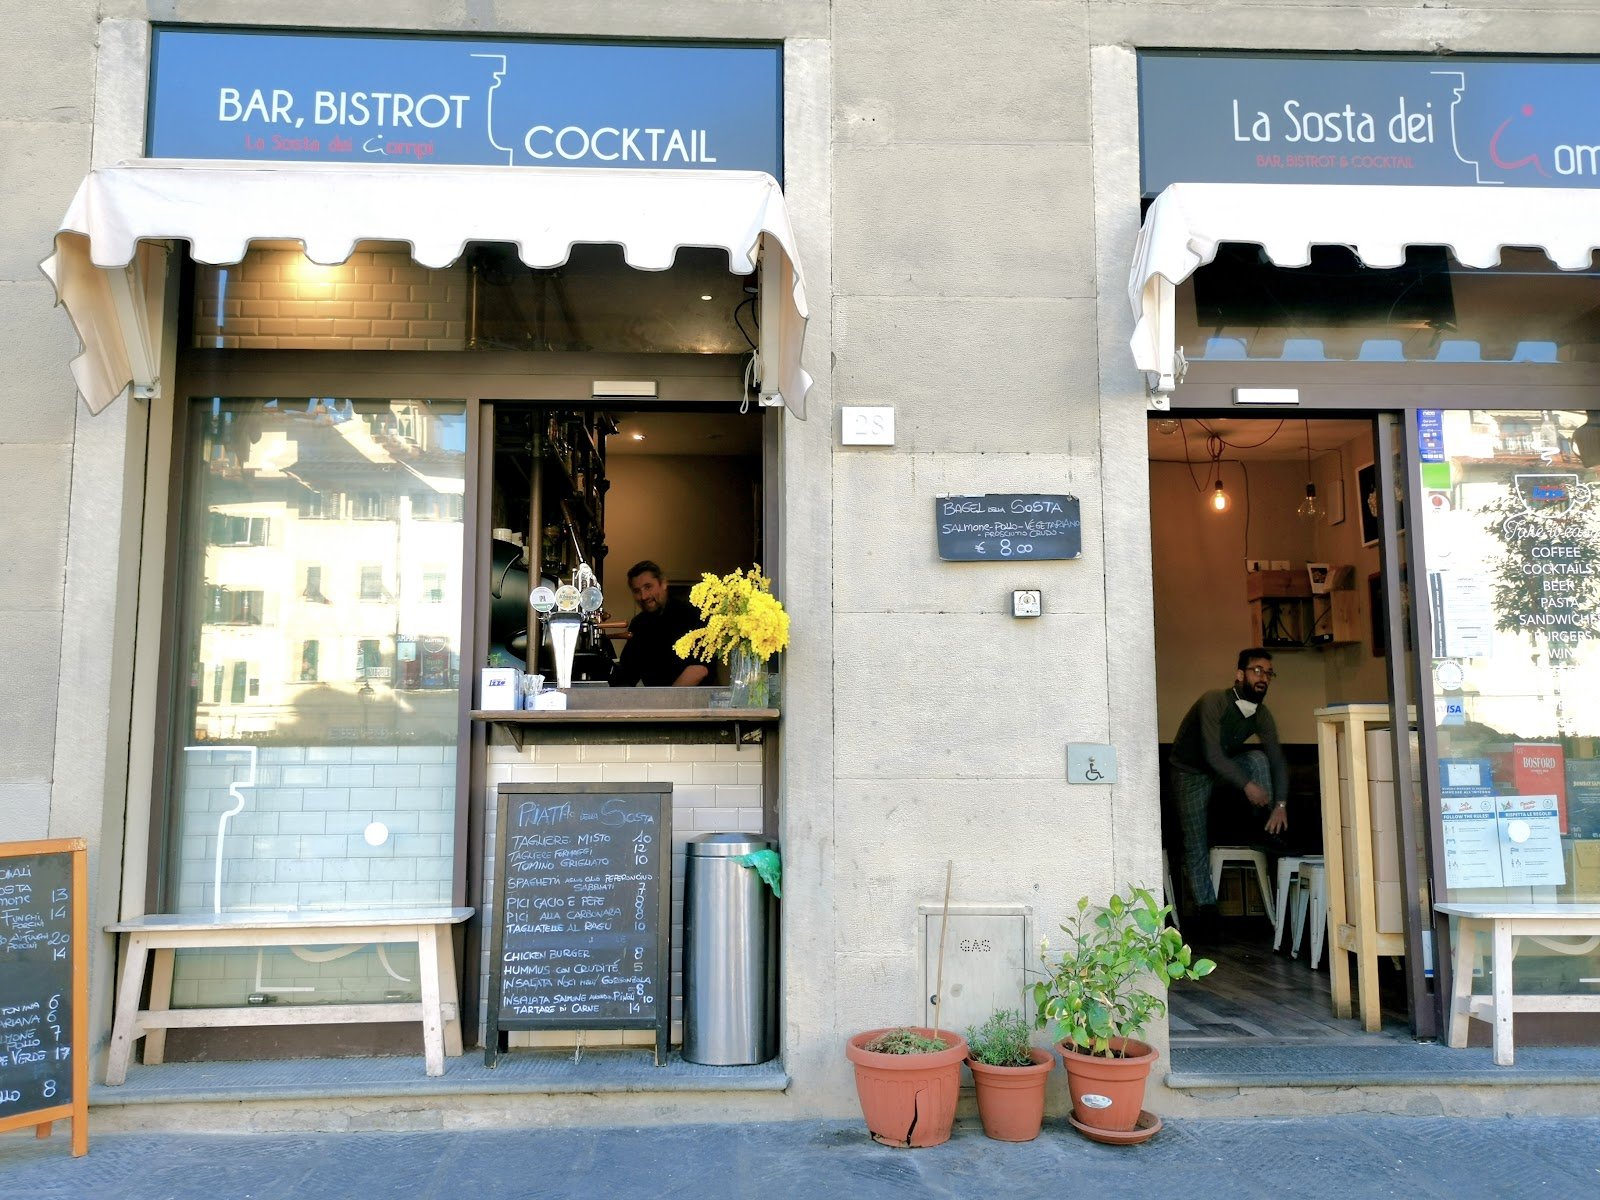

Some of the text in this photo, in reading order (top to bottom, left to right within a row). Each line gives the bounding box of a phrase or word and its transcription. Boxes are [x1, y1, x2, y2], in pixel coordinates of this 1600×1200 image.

[218, 88, 470, 129] BAR, BISTROT
[1233, 99, 1271, 142] La
[1284, 100, 1375, 143] Sosta
[1388, 97, 1434, 144] dei
[245, 135, 264, 150] La
[271, 135, 320, 152] Sosta
[329, 135, 353, 152] dei
[525, 125, 716, 163] COCKTAIL
[1286, 155, 1335, 168] BISTROT
[1352, 156, 1414, 168] COCKTAIL
[943, 502, 986, 515] BAGEL
[1532, 547, 1581, 557] COFFEE
[1523, 564, 1592, 574] COCKTAILS
[1543, 581, 1574, 591] BEER
[1541, 598, 1579, 607] PASTA
[1523, 756, 1556, 769] BOSFORD
[632, 830, 652, 844] 10
[634, 844, 647, 854] 12
[512, 855, 648, 872] TOMINO GRIGLIATO 10
[638, 882, 646, 895] 7
[52, 888, 69, 903] 13
[635, 895, 645, 908] 8
[506, 897, 530, 910] PICI
[50, 905, 66, 920] 14
[567, 907, 622, 920] CARBONARA
[635, 908, 644, 920] 8
[506, 923, 565, 934] TAGLIATELLE
[634, 922, 646, 932] 10
[47, 931, 70, 946] 20
[960, 939, 991, 952] GAS
[53, 947, 66, 961] 14
[504, 947, 644, 962] CHICKEN BURGER 8
[504, 965, 550, 975] HUMMUS
[634, 962, 643, 972] 5
[636, 983, 644, 995] 8
[48, 994, 60, 1010] 6
[503, 995, 551, 1008] INSALATA
[643, 995, 654, 1004] 10
[513, 1005, 556, 1014] TARTARE
[571, 1003, 599, 1013] CARNE
[629, 1002, 640, 1014] 14
[47, 1010, 57, 1023] 6
[50, 1025, 61, 1041] 7
[7, 1039, 40, 1051] POLLO
[11, 1048, 47, 1065] VERDE
[55, 1046, 71, 1060] 17
[43, 1079, 56, 1098] 8
